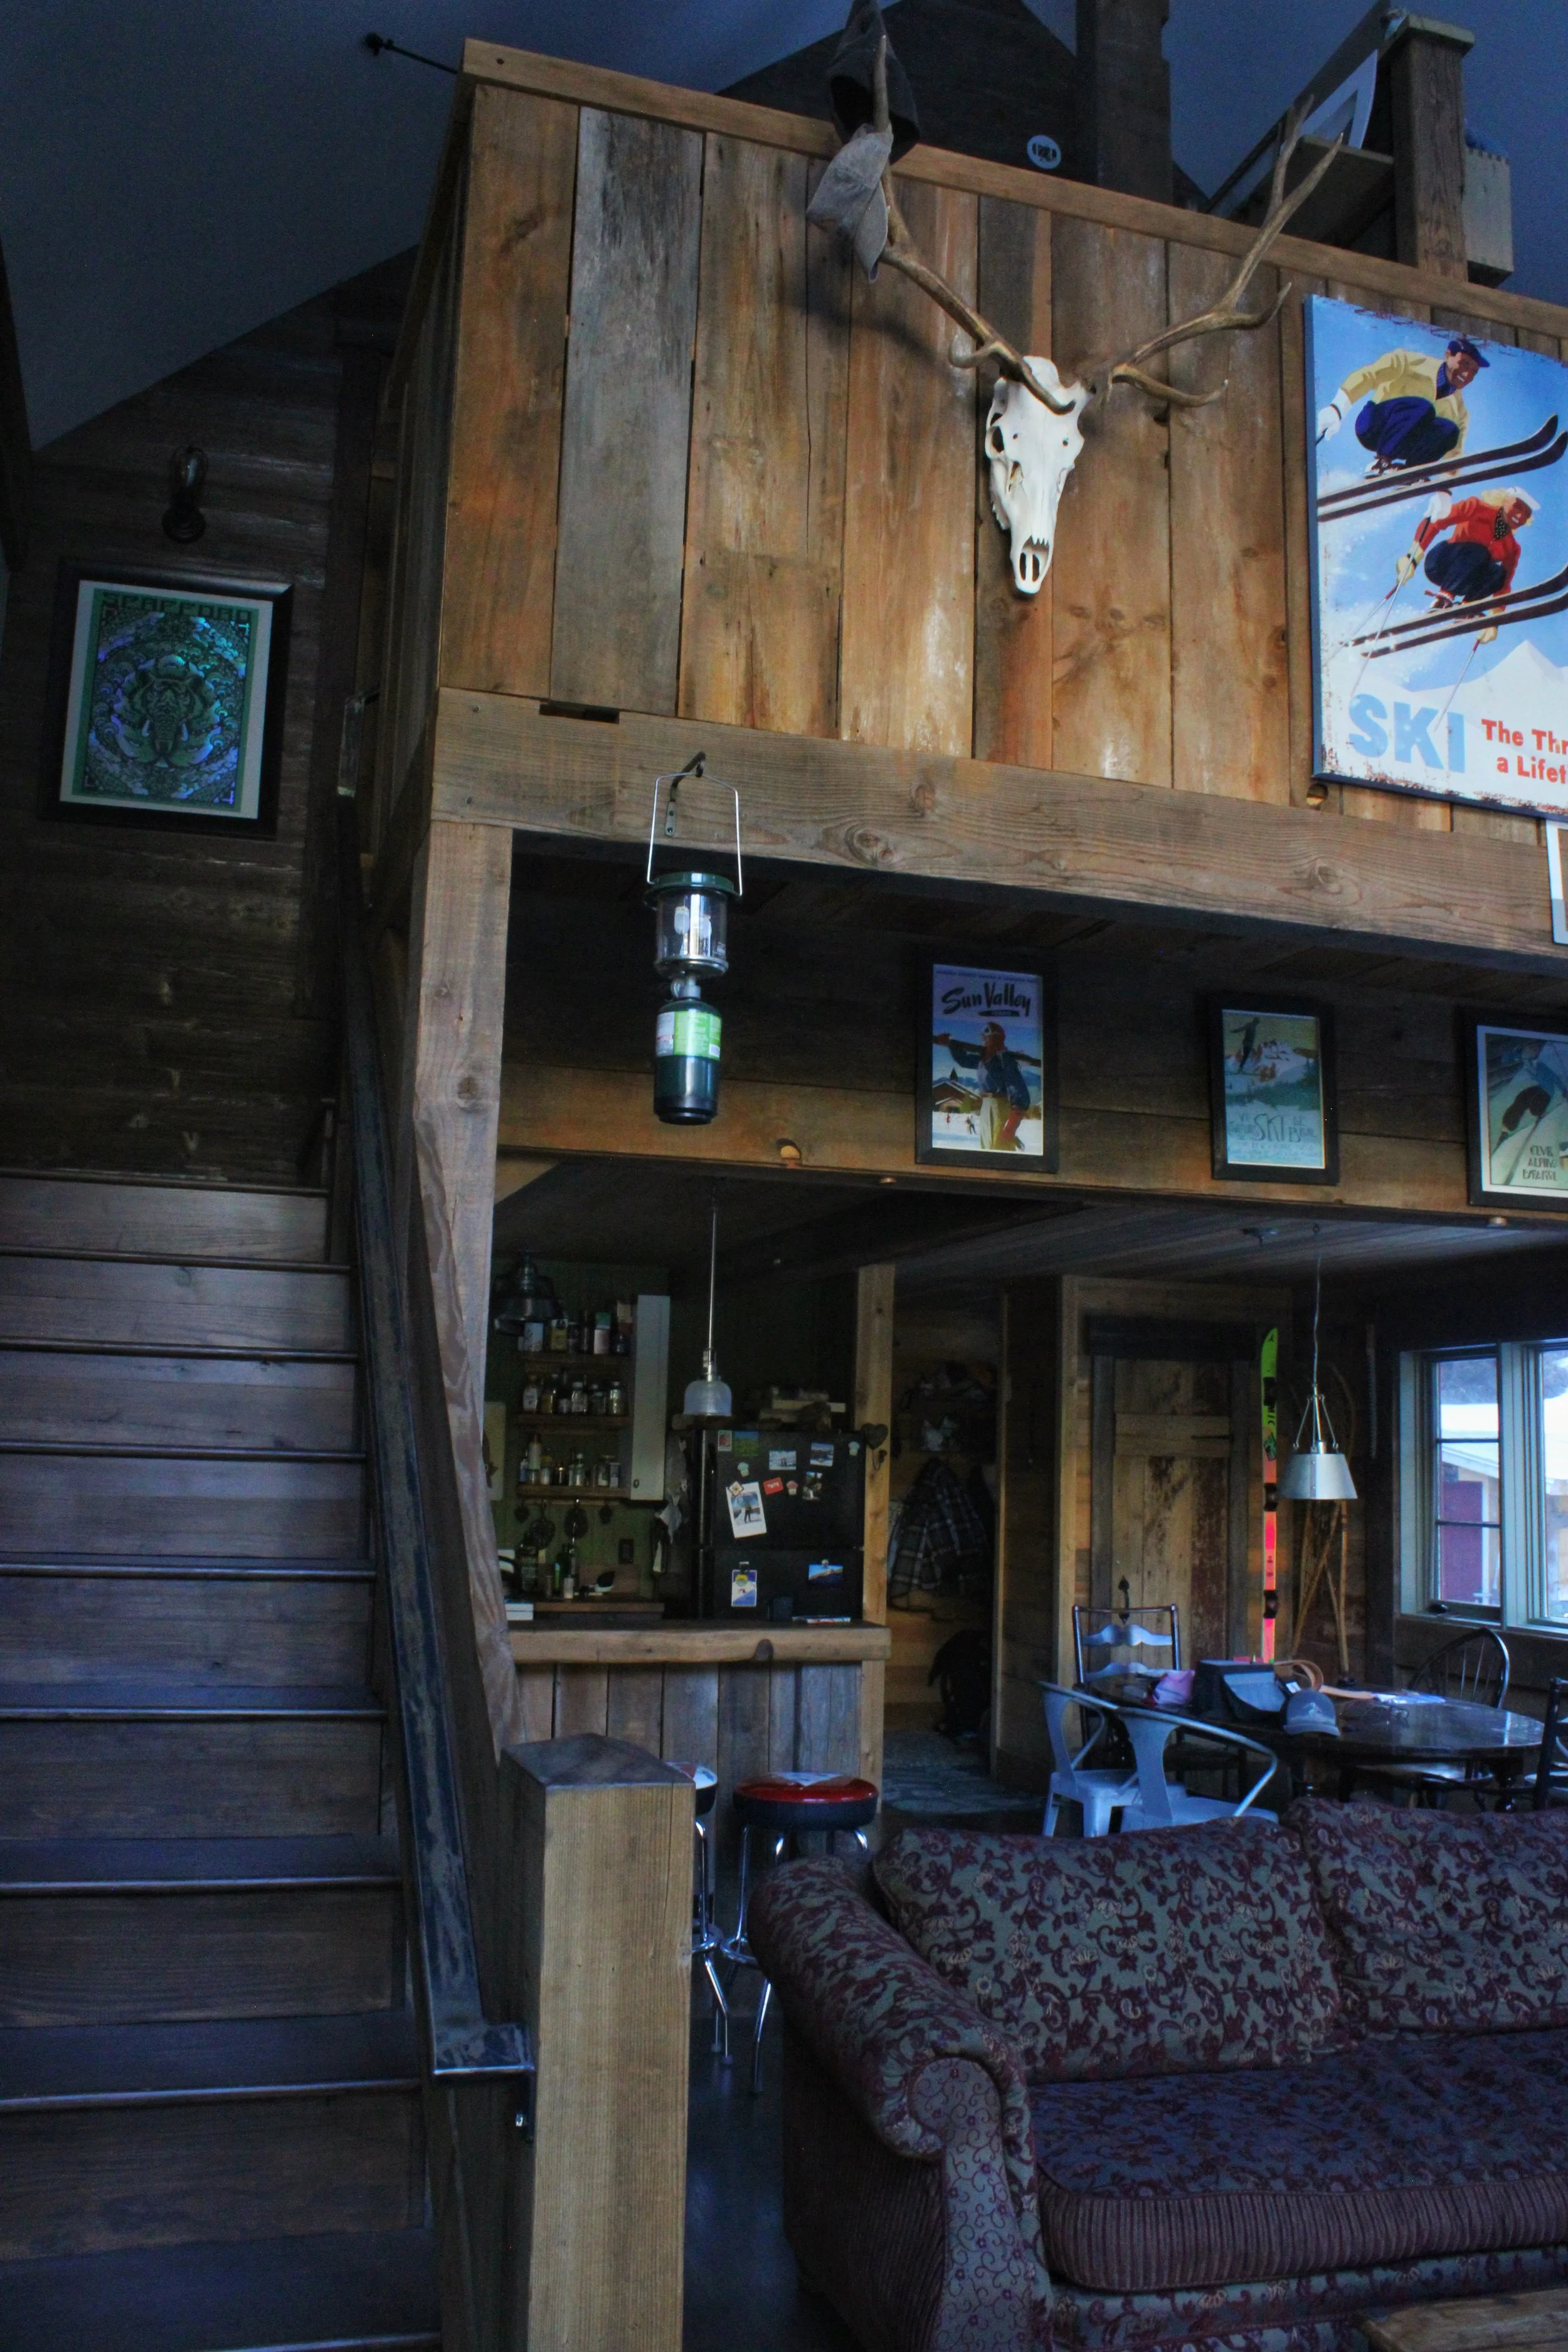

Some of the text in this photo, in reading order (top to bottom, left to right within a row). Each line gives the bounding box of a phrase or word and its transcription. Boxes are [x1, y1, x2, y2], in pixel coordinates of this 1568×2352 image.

[1349, 694, 1465, 773] SKI
[1481, 718, 1524, 747] The
[1496, 756, 1508, 773] a
[941, 982, 1031, 1017] Sun Valley
[1252, 1113, 1284, 1142] SKI
